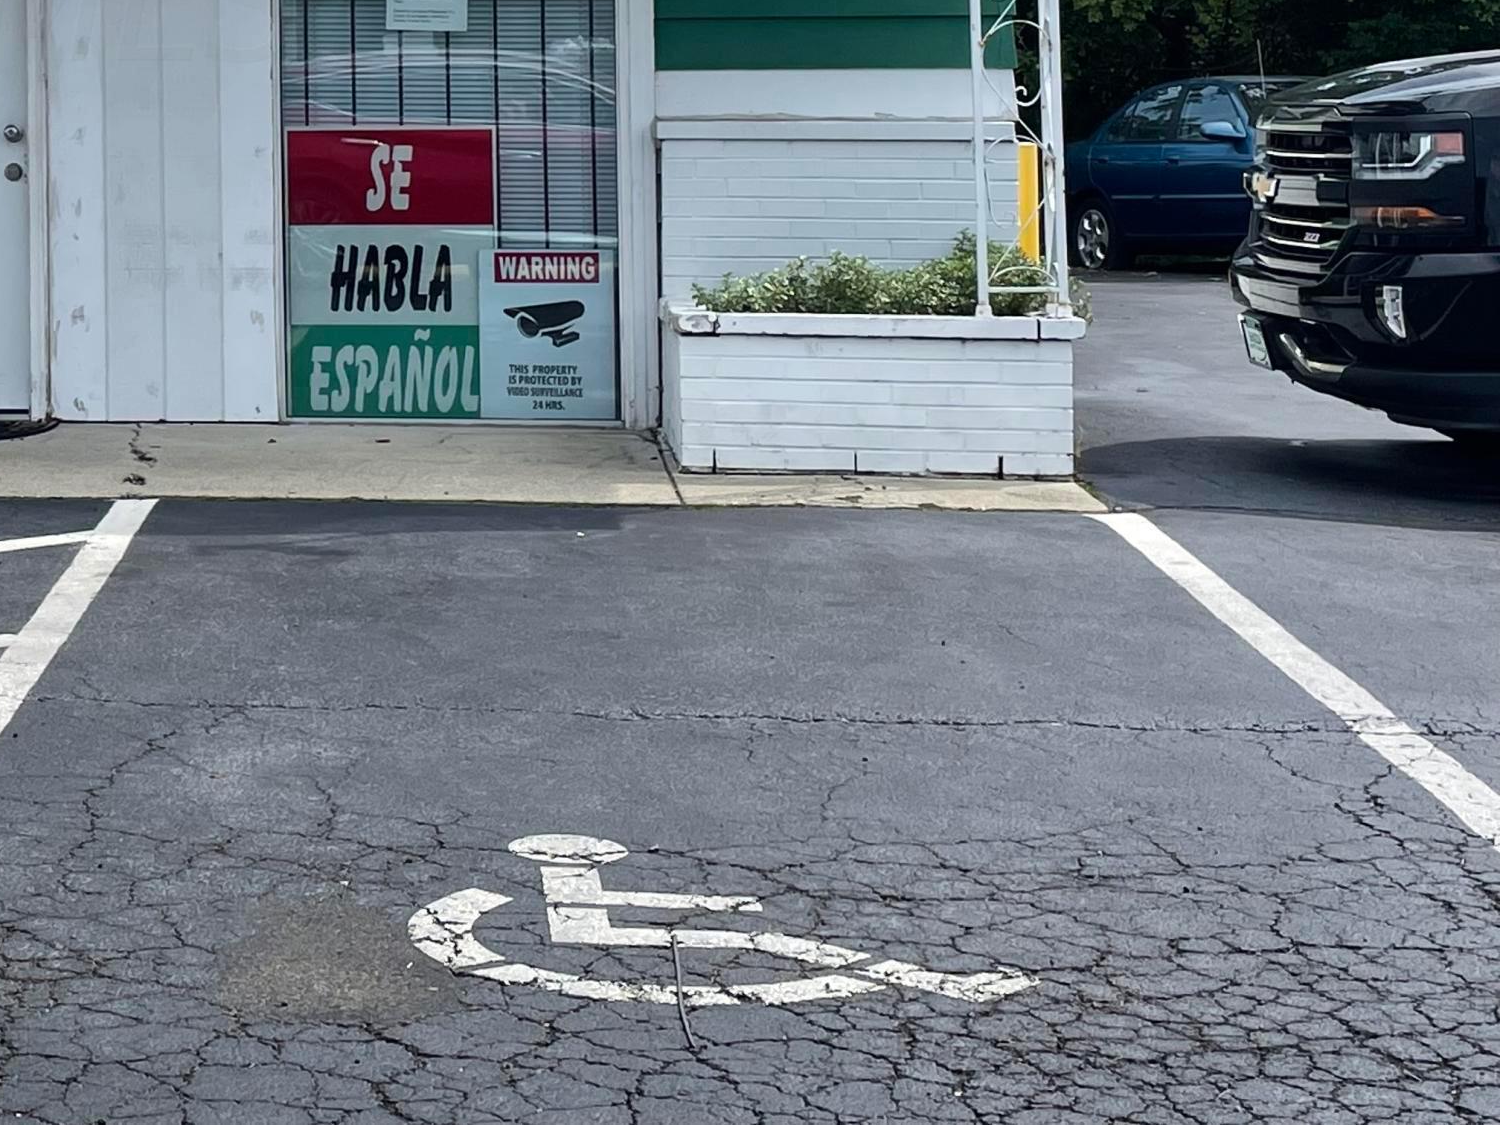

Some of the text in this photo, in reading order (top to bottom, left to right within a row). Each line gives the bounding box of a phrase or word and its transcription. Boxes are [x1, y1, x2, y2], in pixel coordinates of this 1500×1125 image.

[366, 144, 414, 212] SE
[498, 256, 596, 281] WARNING
[330, 244, 453, 313] HABLA
[309, 328, 480, 413] ESPAÑOL
[508, 364, 579, 375] THIS PROPERTY
[508, 375, 583, 387] IS PROTECTED BY
[506, 386, 584, 398] VIDEO SURVEILLANCE
[532, 400, 544, 411] 24
